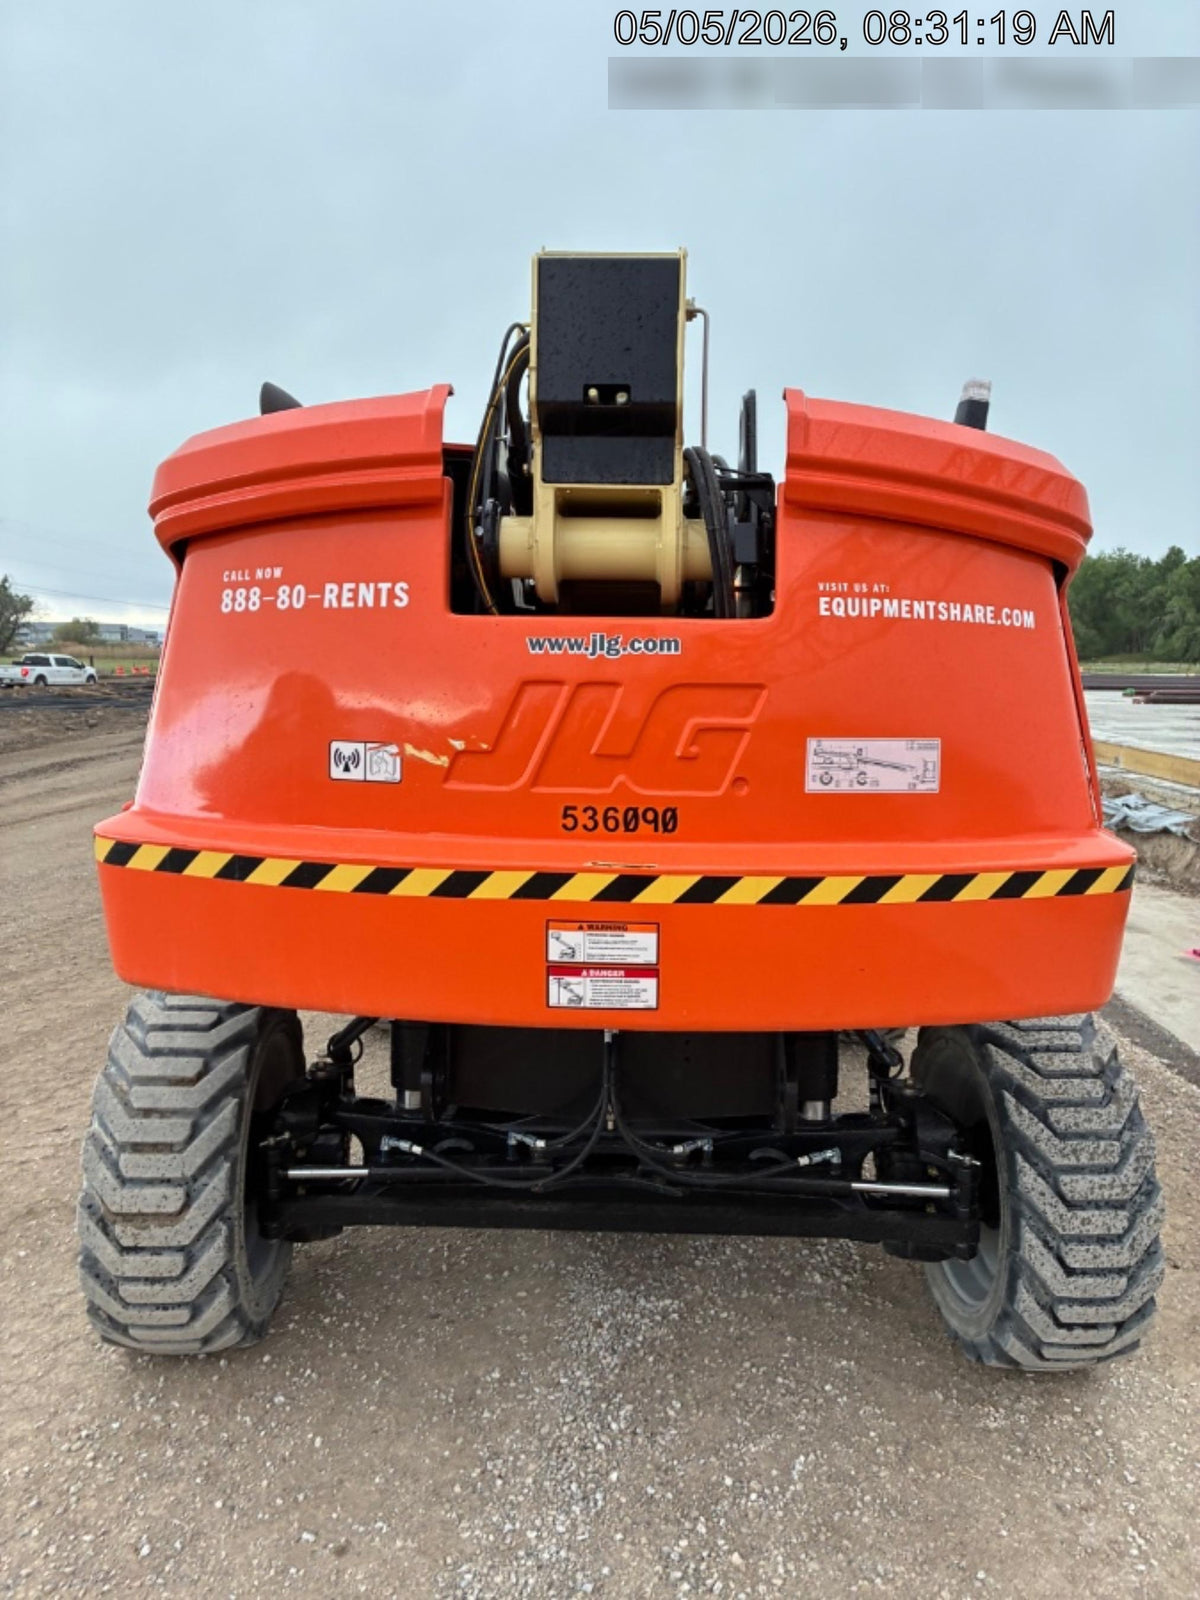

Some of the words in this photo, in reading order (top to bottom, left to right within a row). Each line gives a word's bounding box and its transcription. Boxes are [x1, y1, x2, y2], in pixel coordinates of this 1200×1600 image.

[223, 570, 251, 582] CALL
[255, 567, 283, 580] NOW
[818, 582, 849, 593] VISIT
[853, 583, 868, 593] US
[872, 584, 890, 593] AT:
[220, 581, 410, 614] 888-80-RENTS
[818, 596, 1036, 629] EQUIPMENTSHARE.COM
[526, 633, 682, 657] www.jlg.com
[560, 805, 679, 834] 536090
[586, 923, 629, 932] WARNING
[589, 969, 625, 977] DANGER
